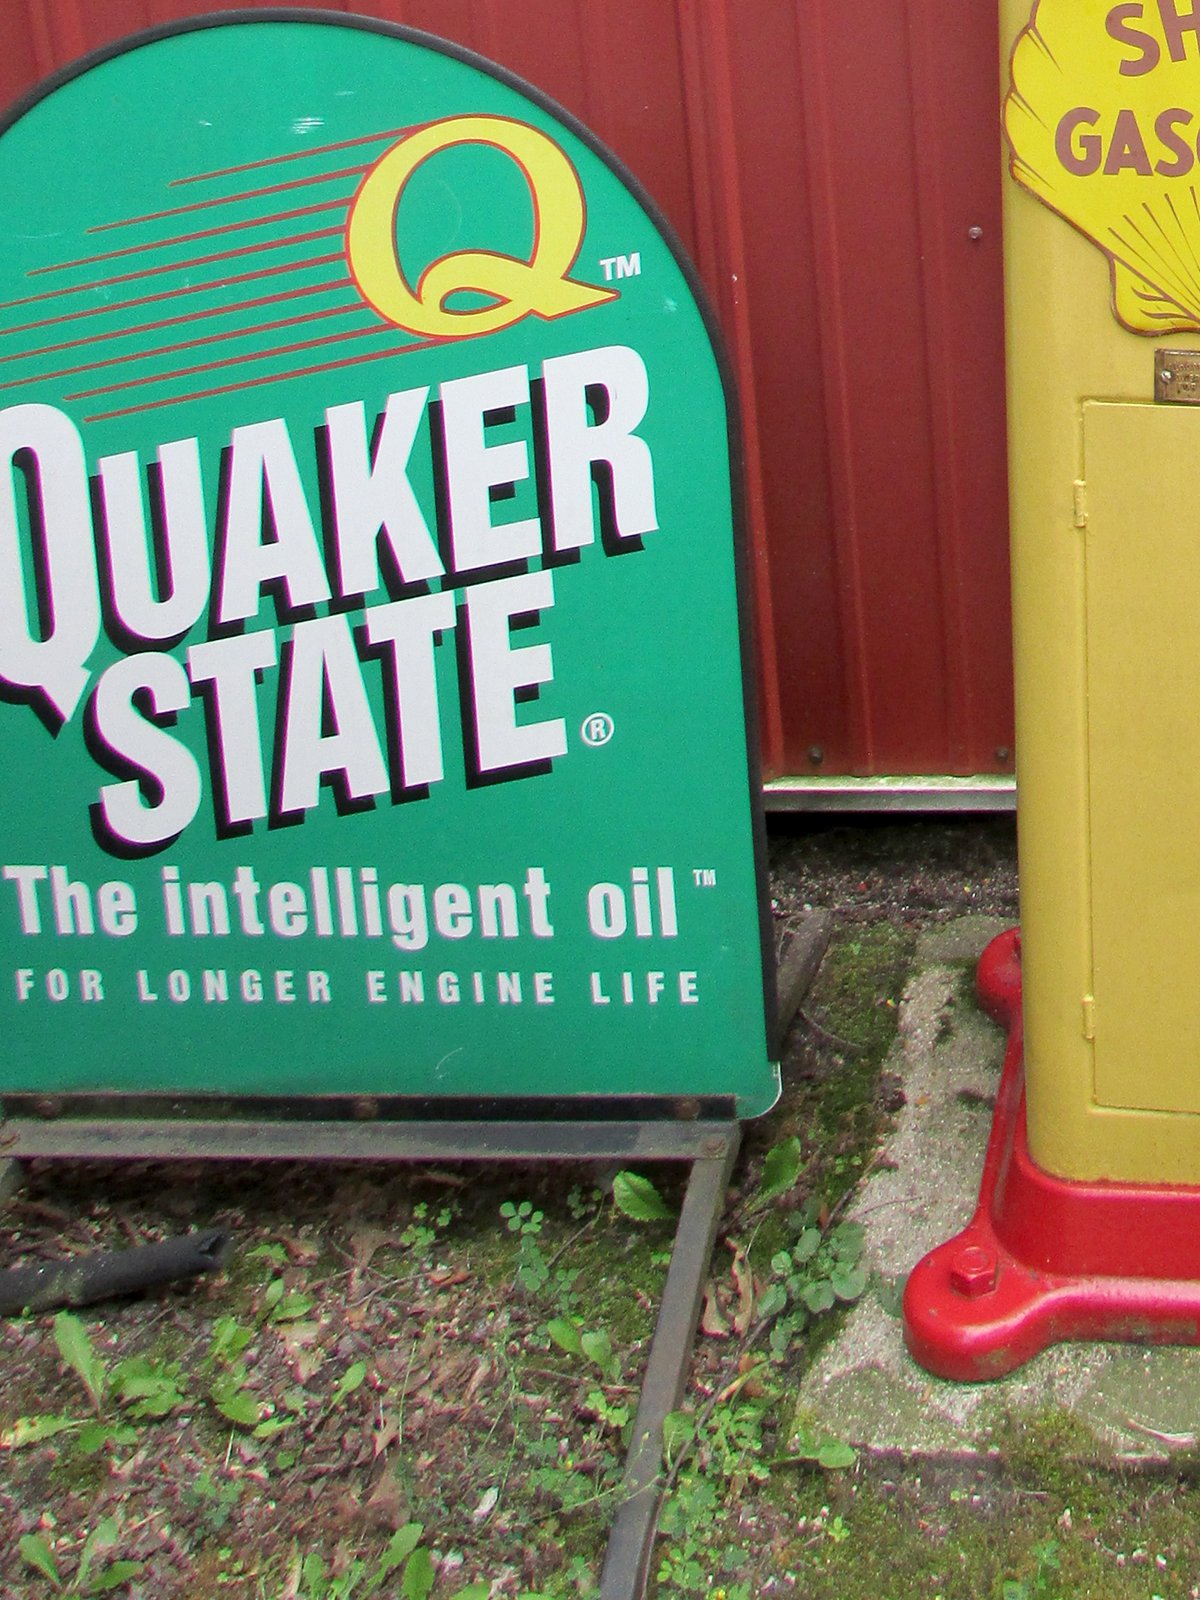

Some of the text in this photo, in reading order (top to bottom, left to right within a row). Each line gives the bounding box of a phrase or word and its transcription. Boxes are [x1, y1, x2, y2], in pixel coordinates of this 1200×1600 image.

[344, 113, 622, 339] Q
[600, 253, 642, 280] TM
[0, 344, 660, 730] QUAKER
[88, 569, 567, 850] STATE
[3, 865, 137, 937] The
[161, 865, 555, 951] intelligent
[588, 866, 678, 938] oil
[15, 968, 699, 1004] FOR LONGER ENGINE LIFE
